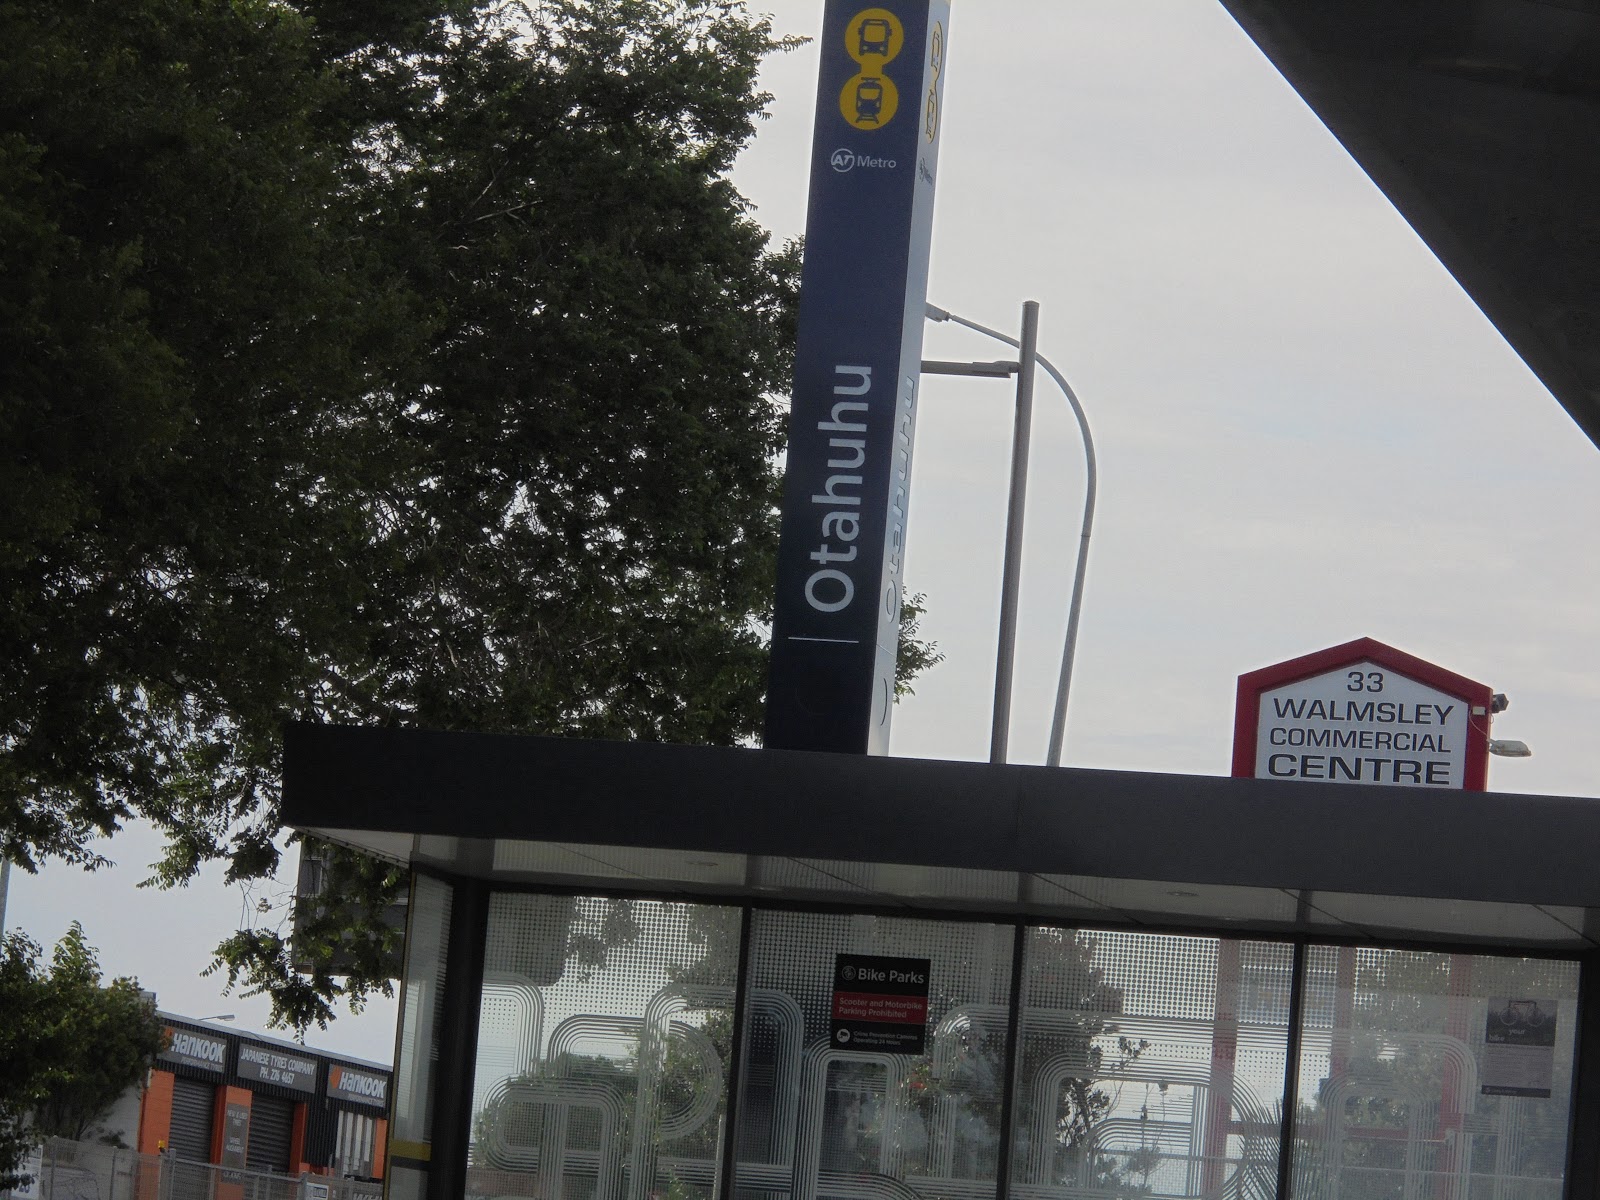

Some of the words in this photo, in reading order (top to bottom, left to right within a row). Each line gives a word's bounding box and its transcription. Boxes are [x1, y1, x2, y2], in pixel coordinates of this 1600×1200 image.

[857, 155, 897, 169] Metro
[804, 364, 872, 613] Otahuhu
[1346, 671, 1384, 693] 33
[1273, 698, 1454, 726] WALMSLEY
[1269, 727, 1451, 753] COMMERCIAL
[1267, 753, 1451, 786] CENTRE
[858, 968, 886, 982] Bike
[889, 970, 924, 984] Parks
[838, 1007, 867, 1017] Parking
[868, 1008, 907, 1018] Prohibited
[839, 998, 868, 1006] Scooter
[869, 1000, 883, 1008] and
[885, 1000, 923, 1010] Motorbike
[241, 1048, 270, 1065] JAPANESE
[270, 1054, 288, 1069] TYRES
[288, 1059, 316, 1075] COMPANY
